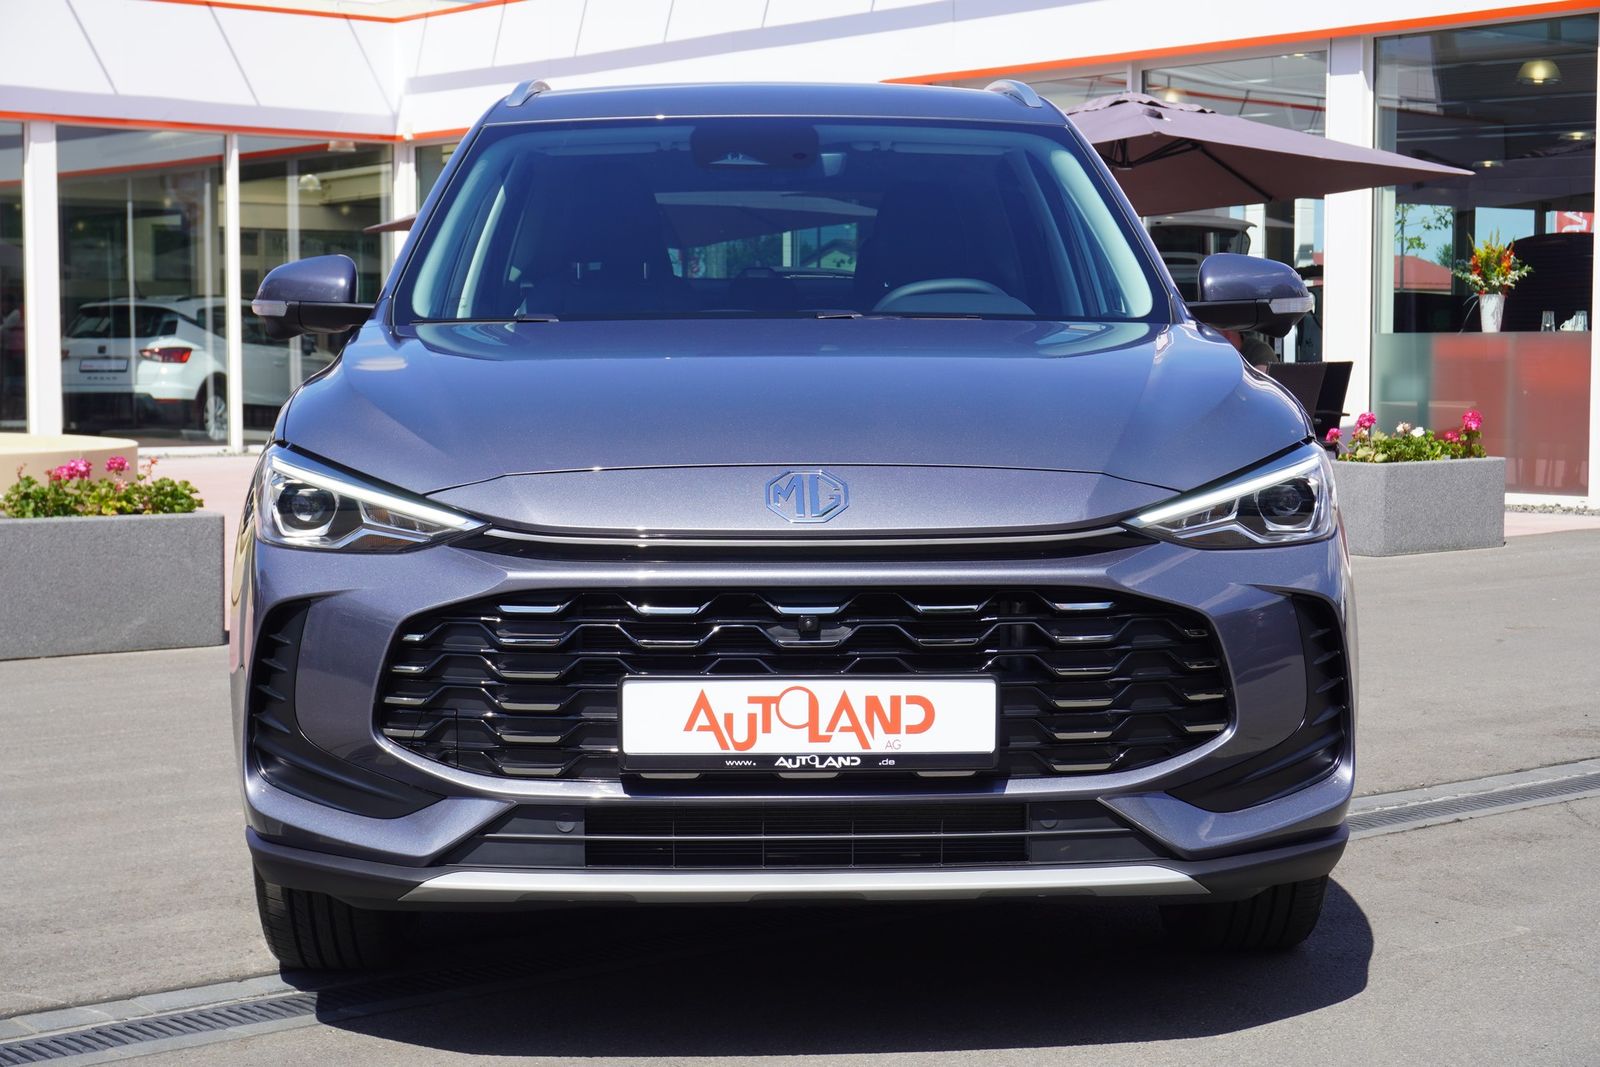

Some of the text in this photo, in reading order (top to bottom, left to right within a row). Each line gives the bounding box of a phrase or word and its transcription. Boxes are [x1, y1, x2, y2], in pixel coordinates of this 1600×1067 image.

[772, 473, 841, 518] MG
[683, 686, 936, 751] AUTOLAND
[884, 739, 902, 750] AG
[774, 754, 861, 768] AUTOLAND
[878, 758, 896, 766] .de
